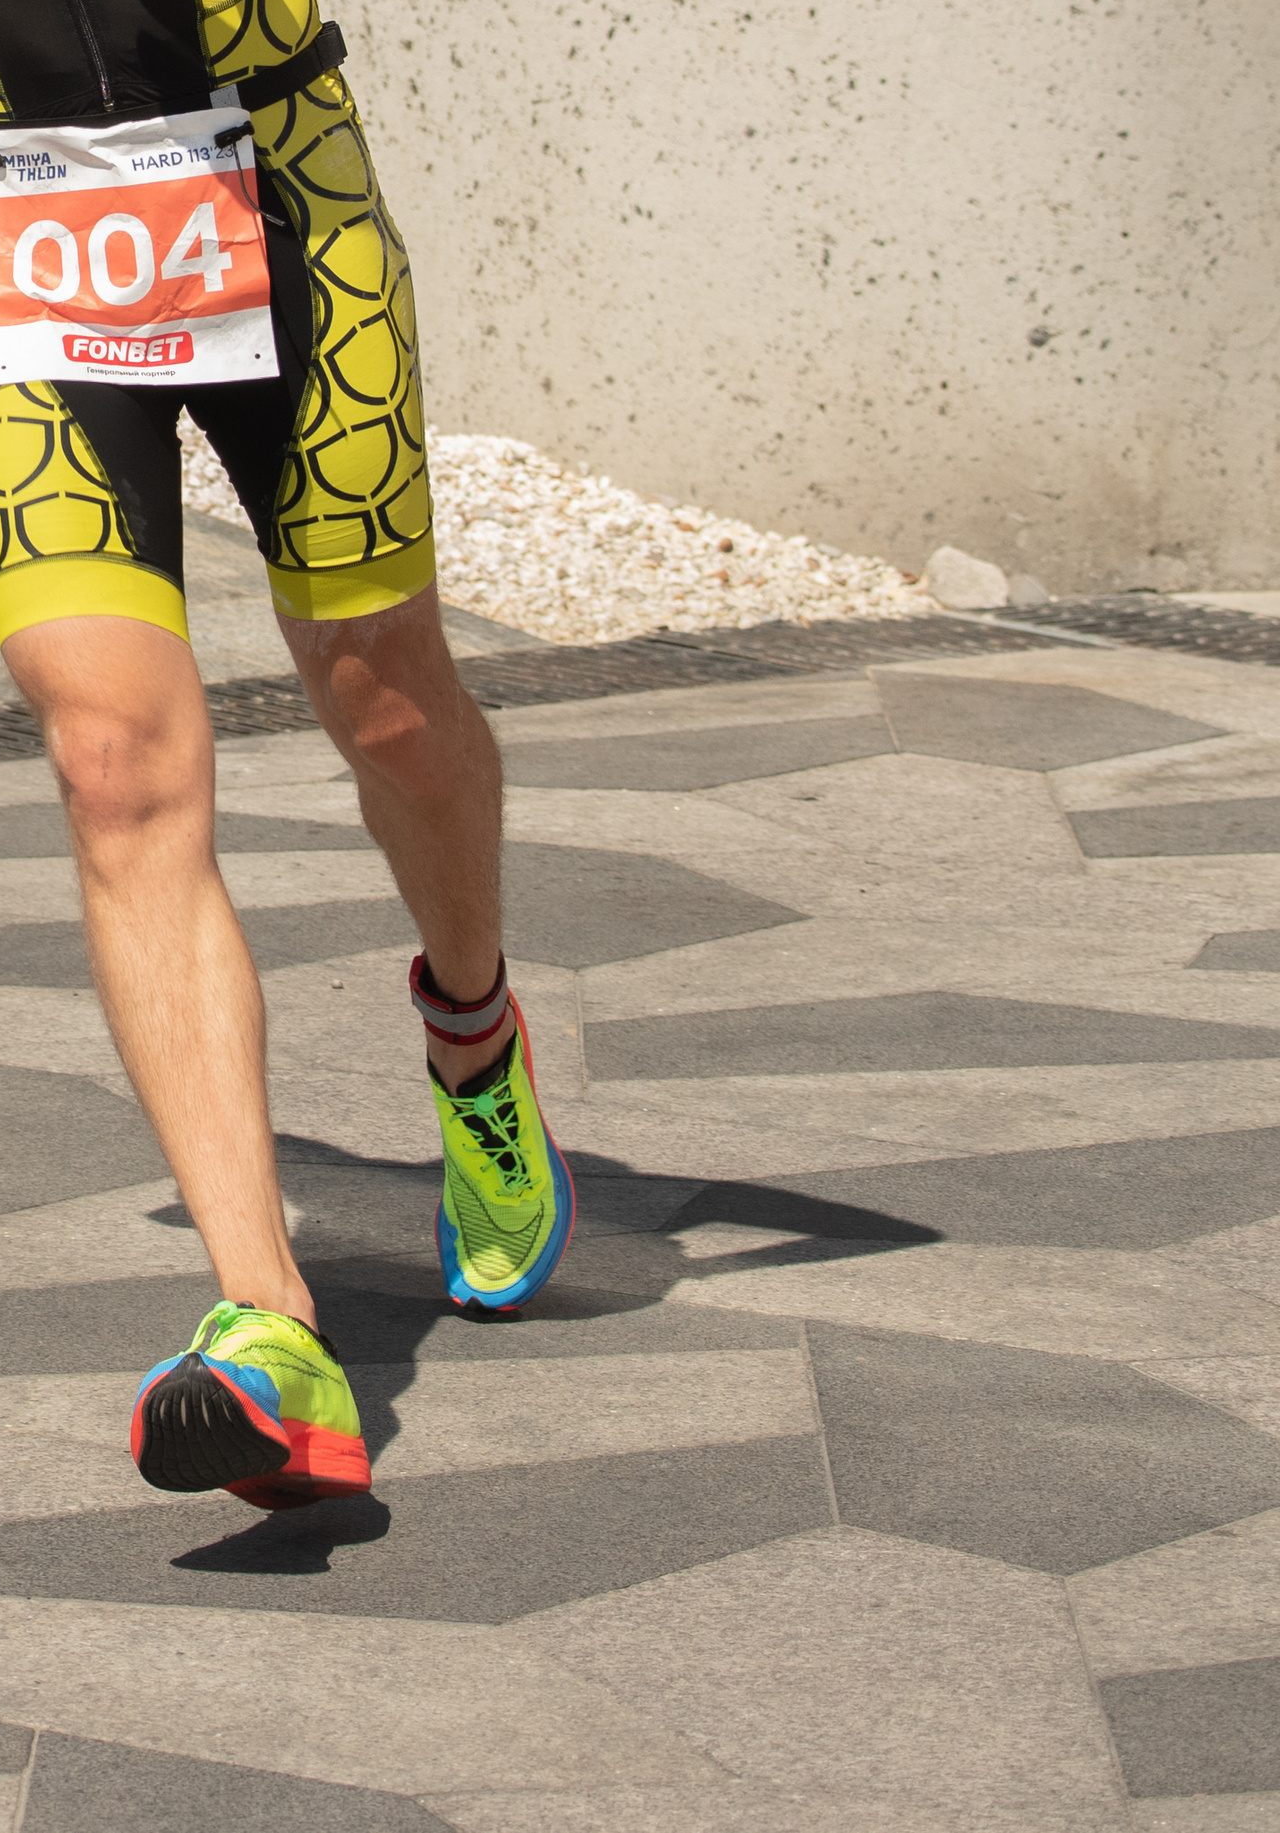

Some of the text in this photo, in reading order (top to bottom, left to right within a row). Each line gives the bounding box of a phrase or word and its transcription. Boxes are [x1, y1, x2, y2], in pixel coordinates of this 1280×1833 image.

[131, 151, 183, 171] HARD
[13, 202, 232, 306] 004
[72, 336, 184, 363] FONBET
